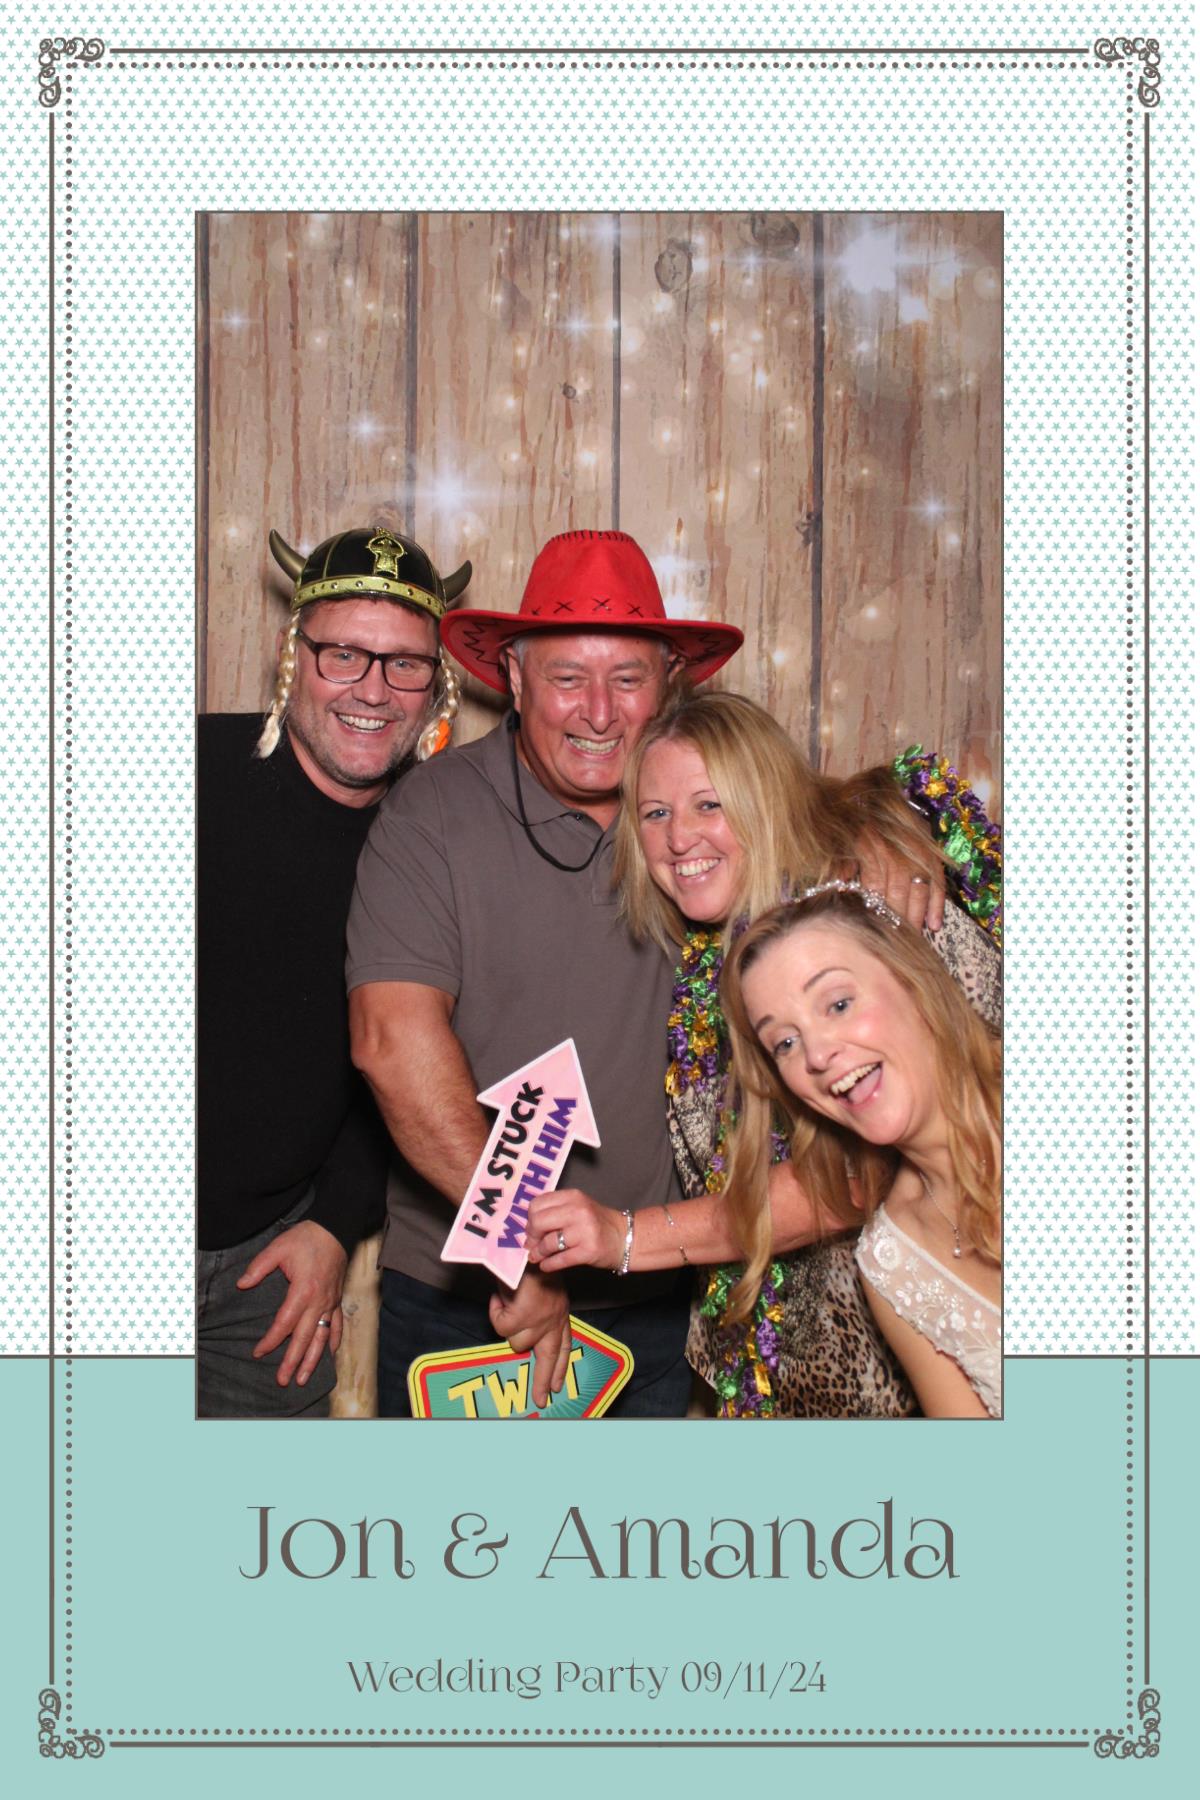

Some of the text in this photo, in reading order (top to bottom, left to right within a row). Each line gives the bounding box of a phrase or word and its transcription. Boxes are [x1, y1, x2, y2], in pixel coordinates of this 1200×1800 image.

[464, 1081, 544, 1239] I'M STUCK
[498, 1097, 578, 1248] WITH HIM
[448, 1347, 583, 1417] TWT
